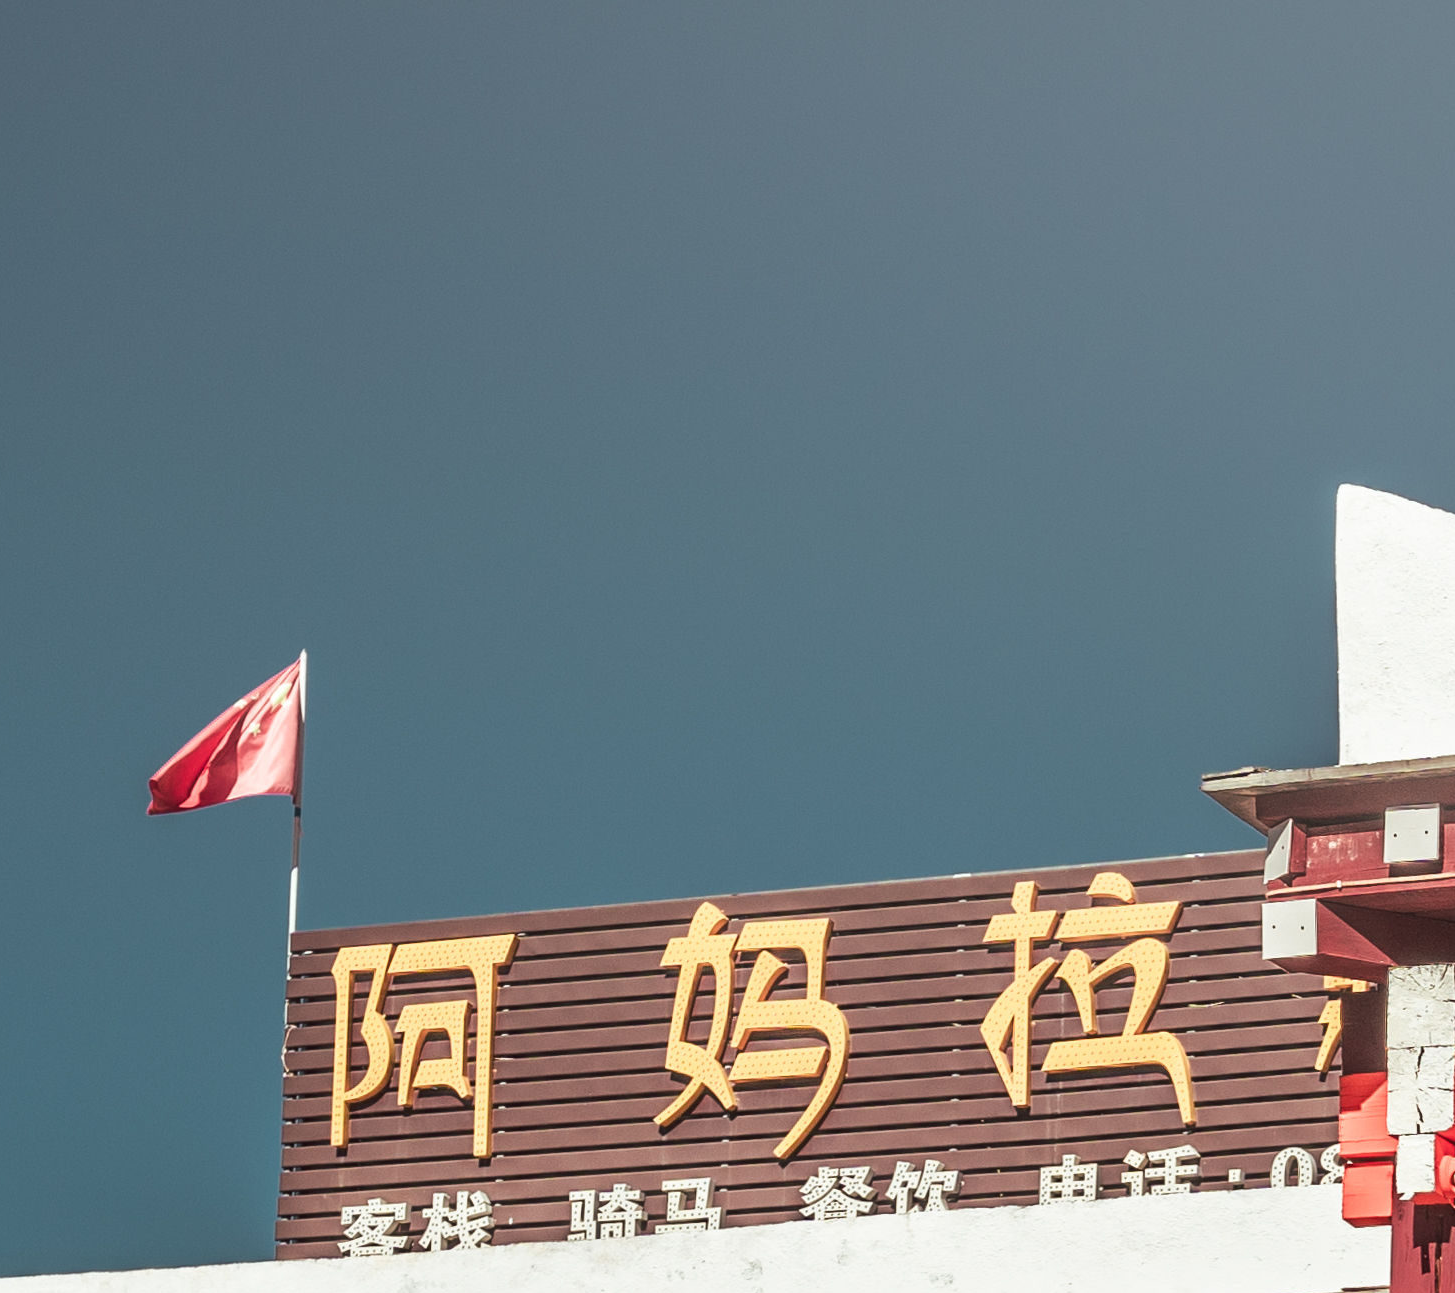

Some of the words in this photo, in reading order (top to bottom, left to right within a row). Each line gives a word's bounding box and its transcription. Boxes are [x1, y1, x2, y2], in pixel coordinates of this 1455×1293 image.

[331, 871, 1373, 1161] 阿妈拉
[337, 1190, 495, 1257] 客栈
[567, 1177, 724, 1242] 骑马
[798, 1159, 964, 1222] 餐饮
